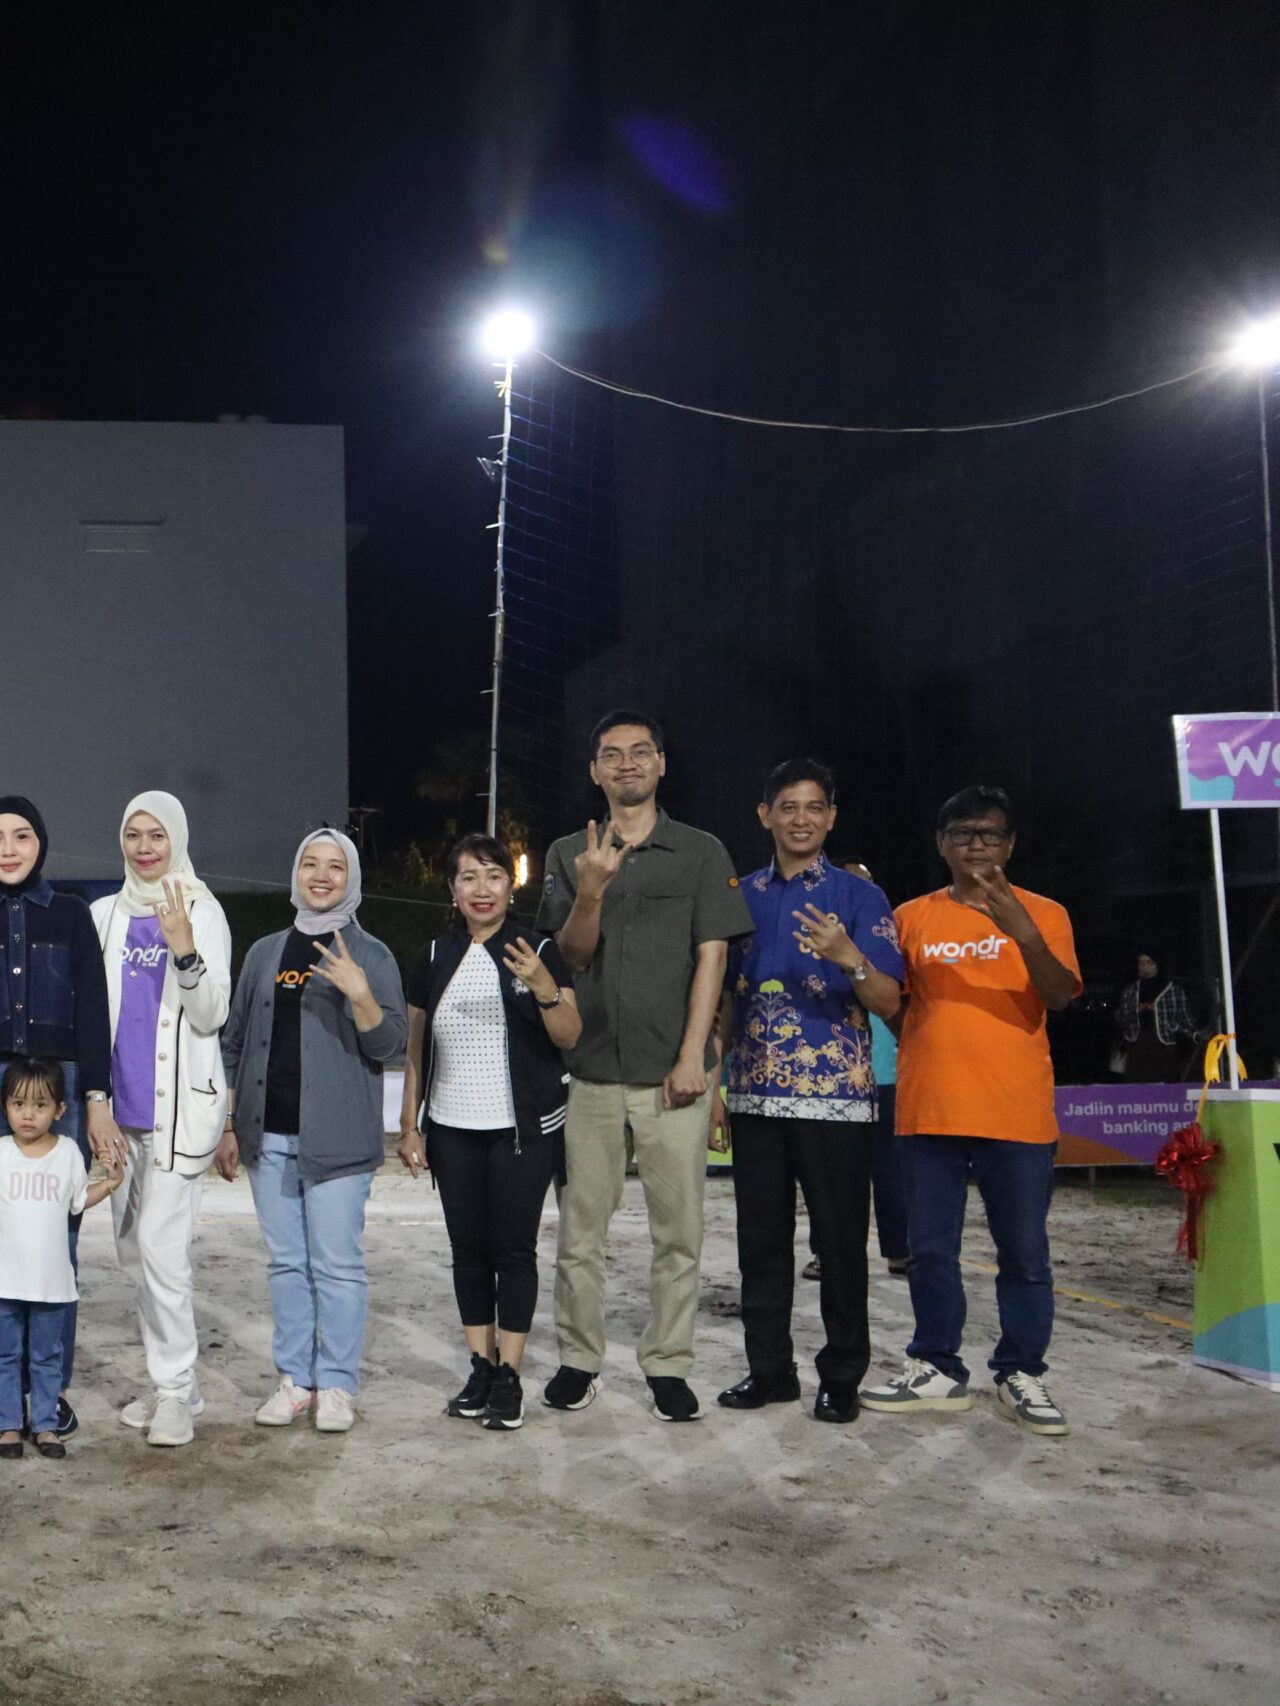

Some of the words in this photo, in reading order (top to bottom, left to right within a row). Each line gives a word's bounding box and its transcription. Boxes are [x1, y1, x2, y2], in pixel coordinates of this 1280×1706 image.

[923, 934, 1008, 958] wondr
[1065, 1101, 1113, 1116] Jadiin
[1118, 1102, 1179, 1114] maumu
[1103, 1119, 1169, 1135] banking
[9, 1171, 61, 1203] DIOR
